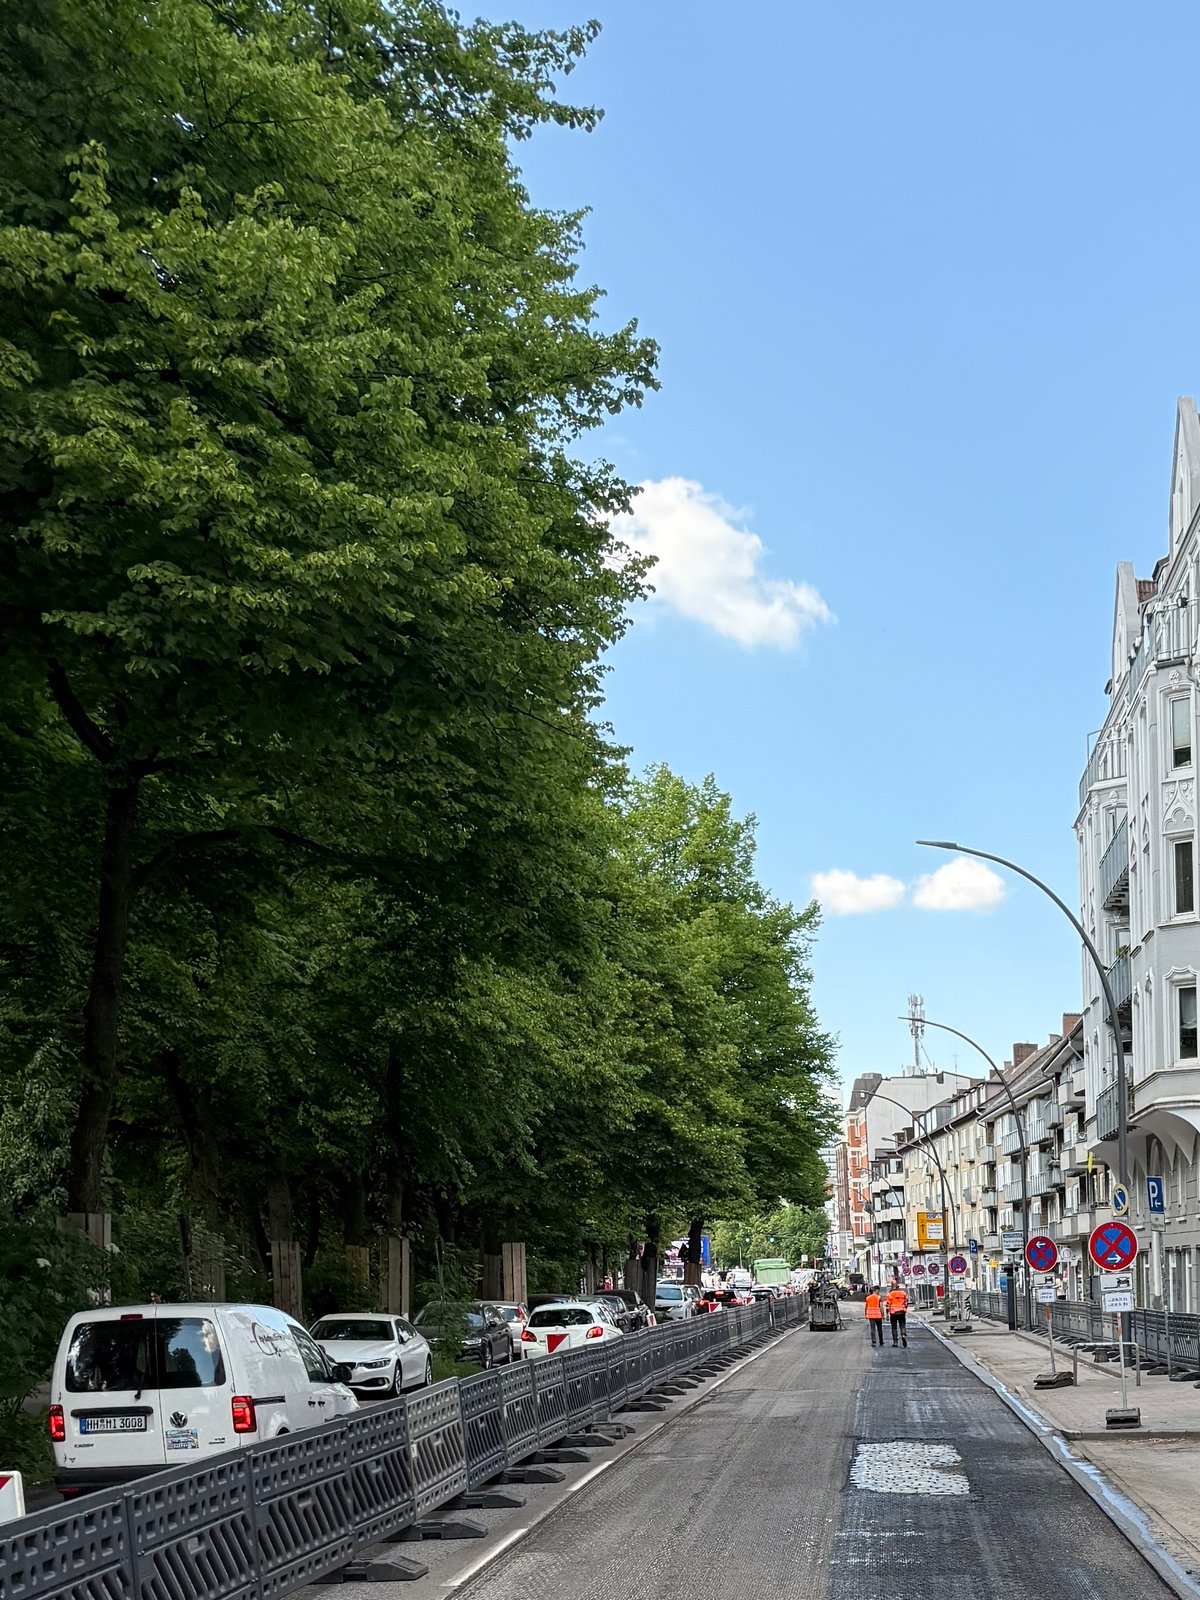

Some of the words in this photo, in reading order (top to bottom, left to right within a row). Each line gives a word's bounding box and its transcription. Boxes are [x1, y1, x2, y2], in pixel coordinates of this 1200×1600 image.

[1148, 1181, 1158, 1207] P
[87, 1418, 99, 1429] HH
[120, 1418, 143, 1428] 3008
